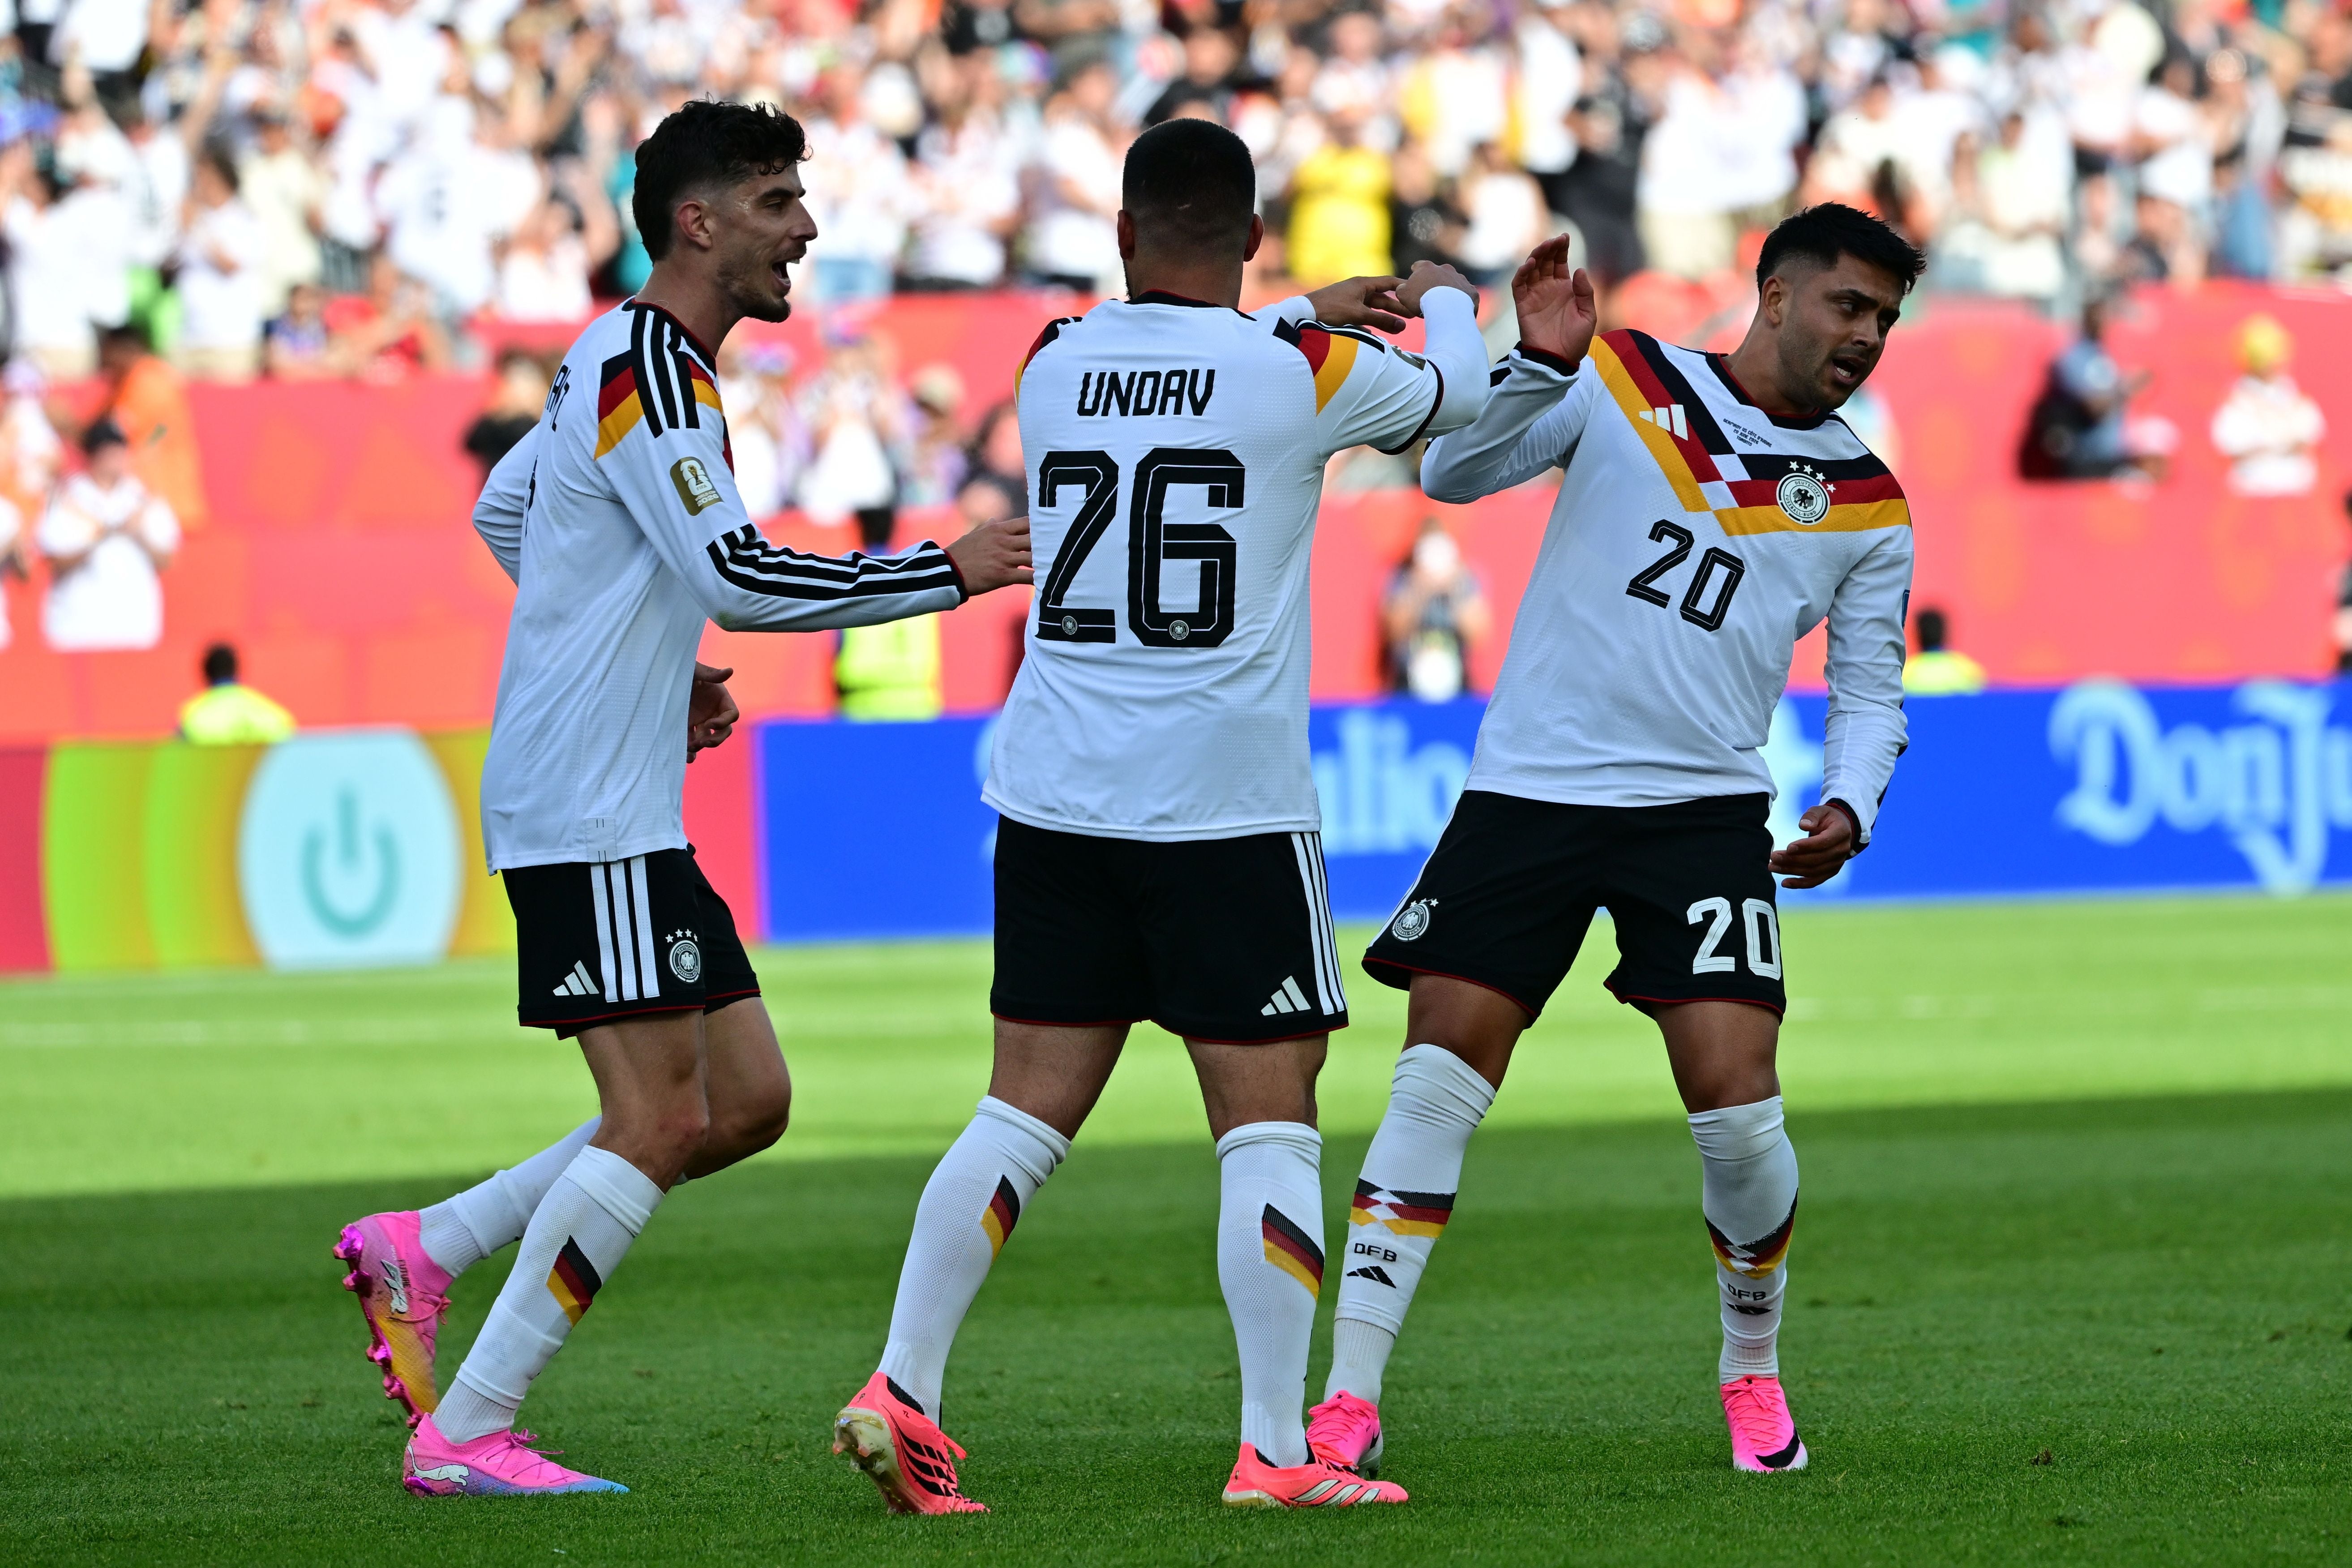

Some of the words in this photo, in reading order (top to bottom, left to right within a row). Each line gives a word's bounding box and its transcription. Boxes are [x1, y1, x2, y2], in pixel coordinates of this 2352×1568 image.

[1076, 368, 1216, 417] UNDAV
[1723, 418, 1742, 430] GERMANY
[1736, 435, 1752, 447] TORONTO
[1748, 437, 1759, 445] 2026
[1795, 481, 1821, 498] DEUTSCHER
[697, 493, 719, 507] 2026
[1035, 447, 1246, 648] 26
[1625, 518, 1745, 632] 20
[1687, 896, 1781, 981] 20
[1354, 1243, 1397, 1262] DFB
[1727, 1283, 1766, 1301] DFB
